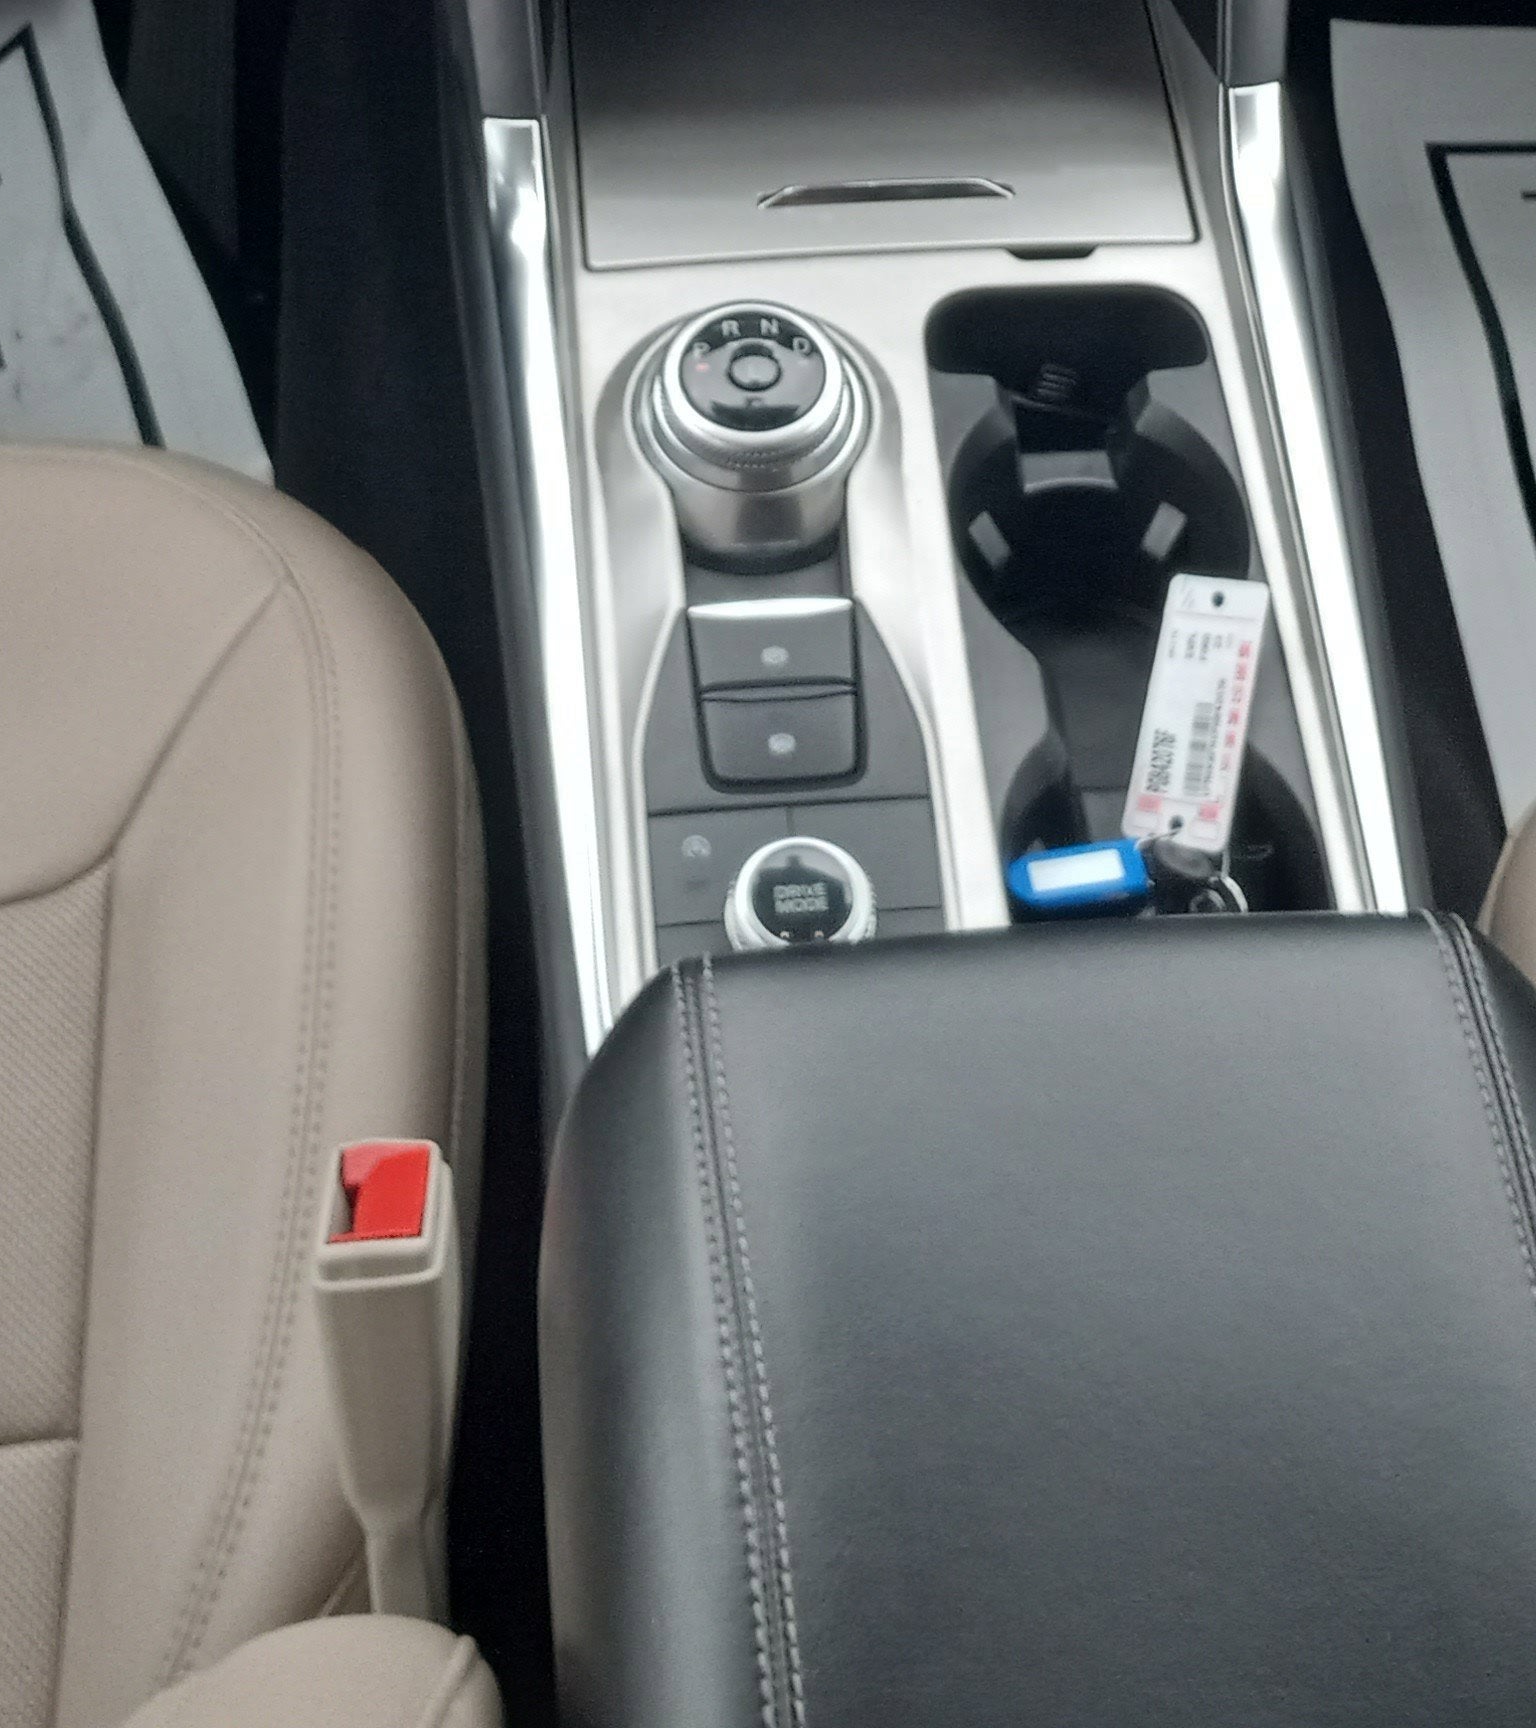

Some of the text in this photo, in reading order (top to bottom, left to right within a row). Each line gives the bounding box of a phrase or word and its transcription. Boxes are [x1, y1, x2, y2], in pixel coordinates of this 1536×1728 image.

[693, 318, 811, 358] P R N D
